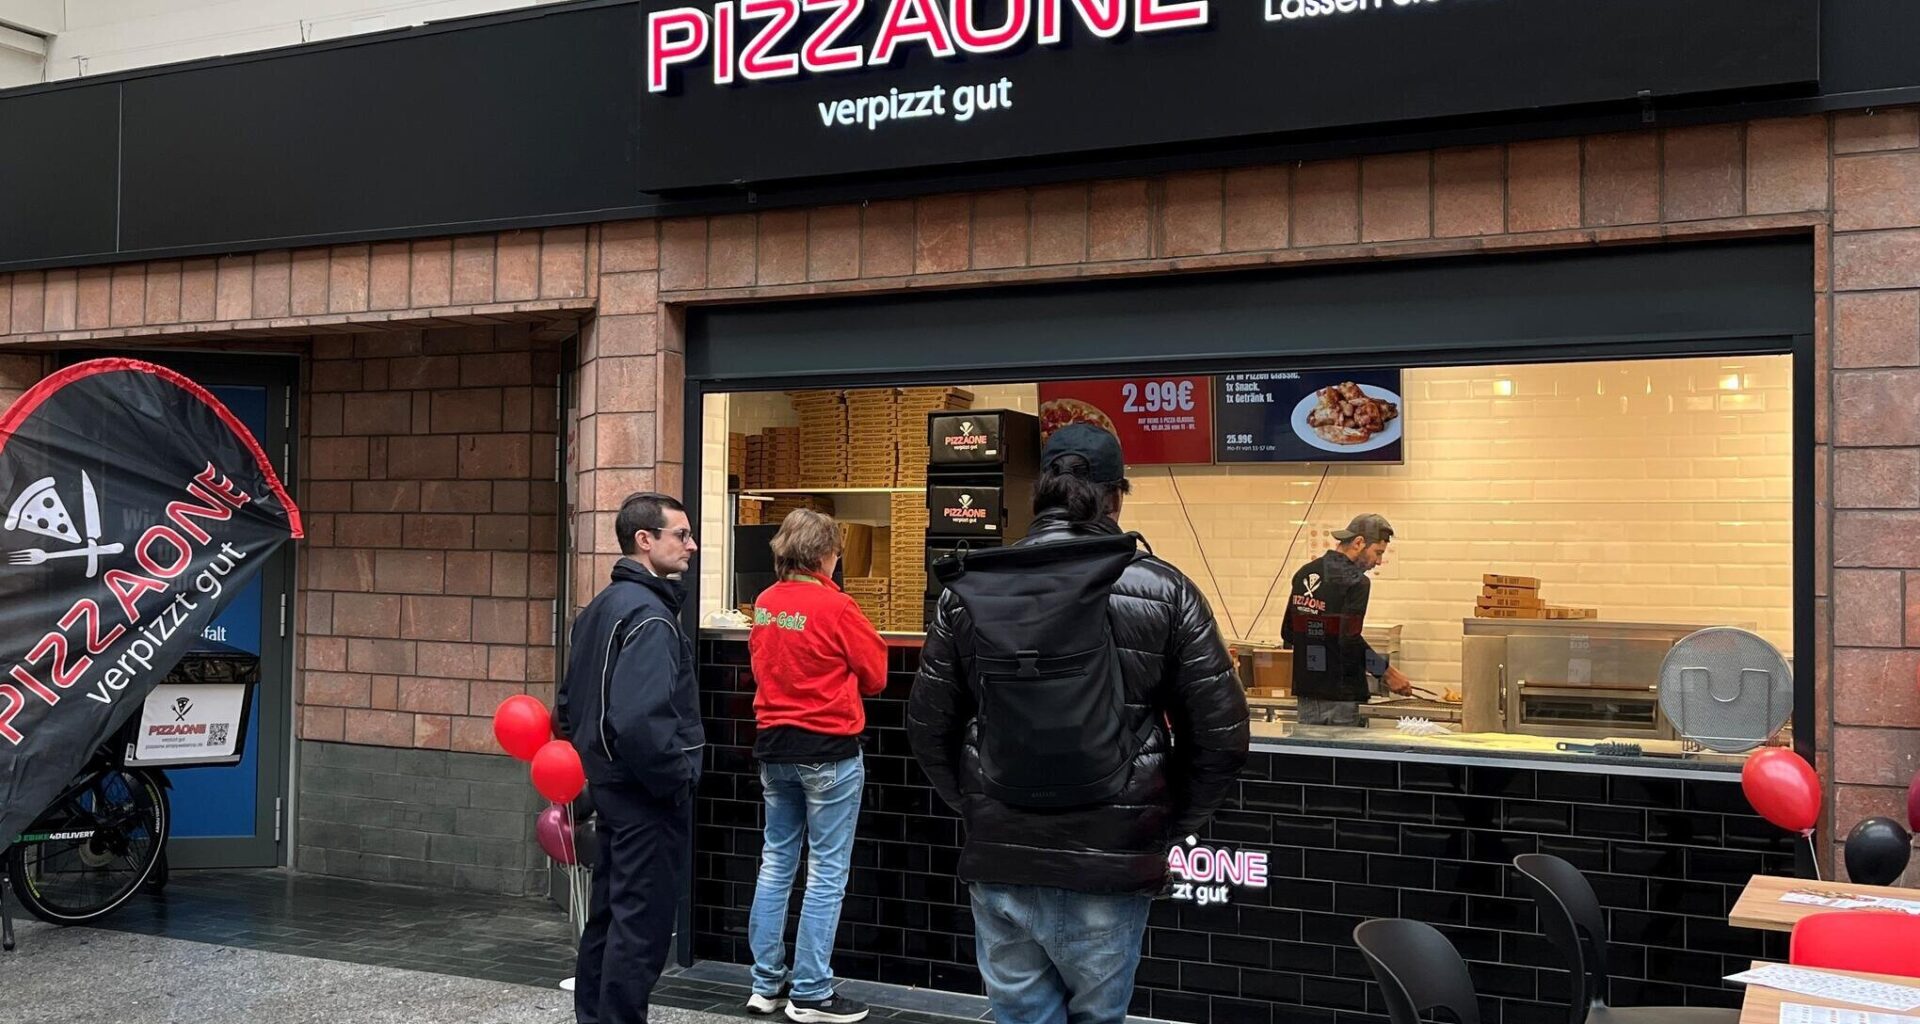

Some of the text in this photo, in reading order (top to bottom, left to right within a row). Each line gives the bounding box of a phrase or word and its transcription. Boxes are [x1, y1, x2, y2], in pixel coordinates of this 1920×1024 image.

[818, 77, 1014, 130] verpizzt gut
[1122, 381, 1195, 413] 2.99€
[1235, 392, 1265, 403] Getränk
[945, 435, 987, 446] PIZZAONE
[1227, 434, 1253, 444] 25.99€
[943, 508, 987, 518] PIZZAONE
[0, 461, 251, 746] PIZZAONE
[86, 541, 247, 705] verpizzt gut
[200, 625, 227, 642] falt
[1168, 845, 1268, 887] AONE
[1195, 885, 1229, 905] gut
